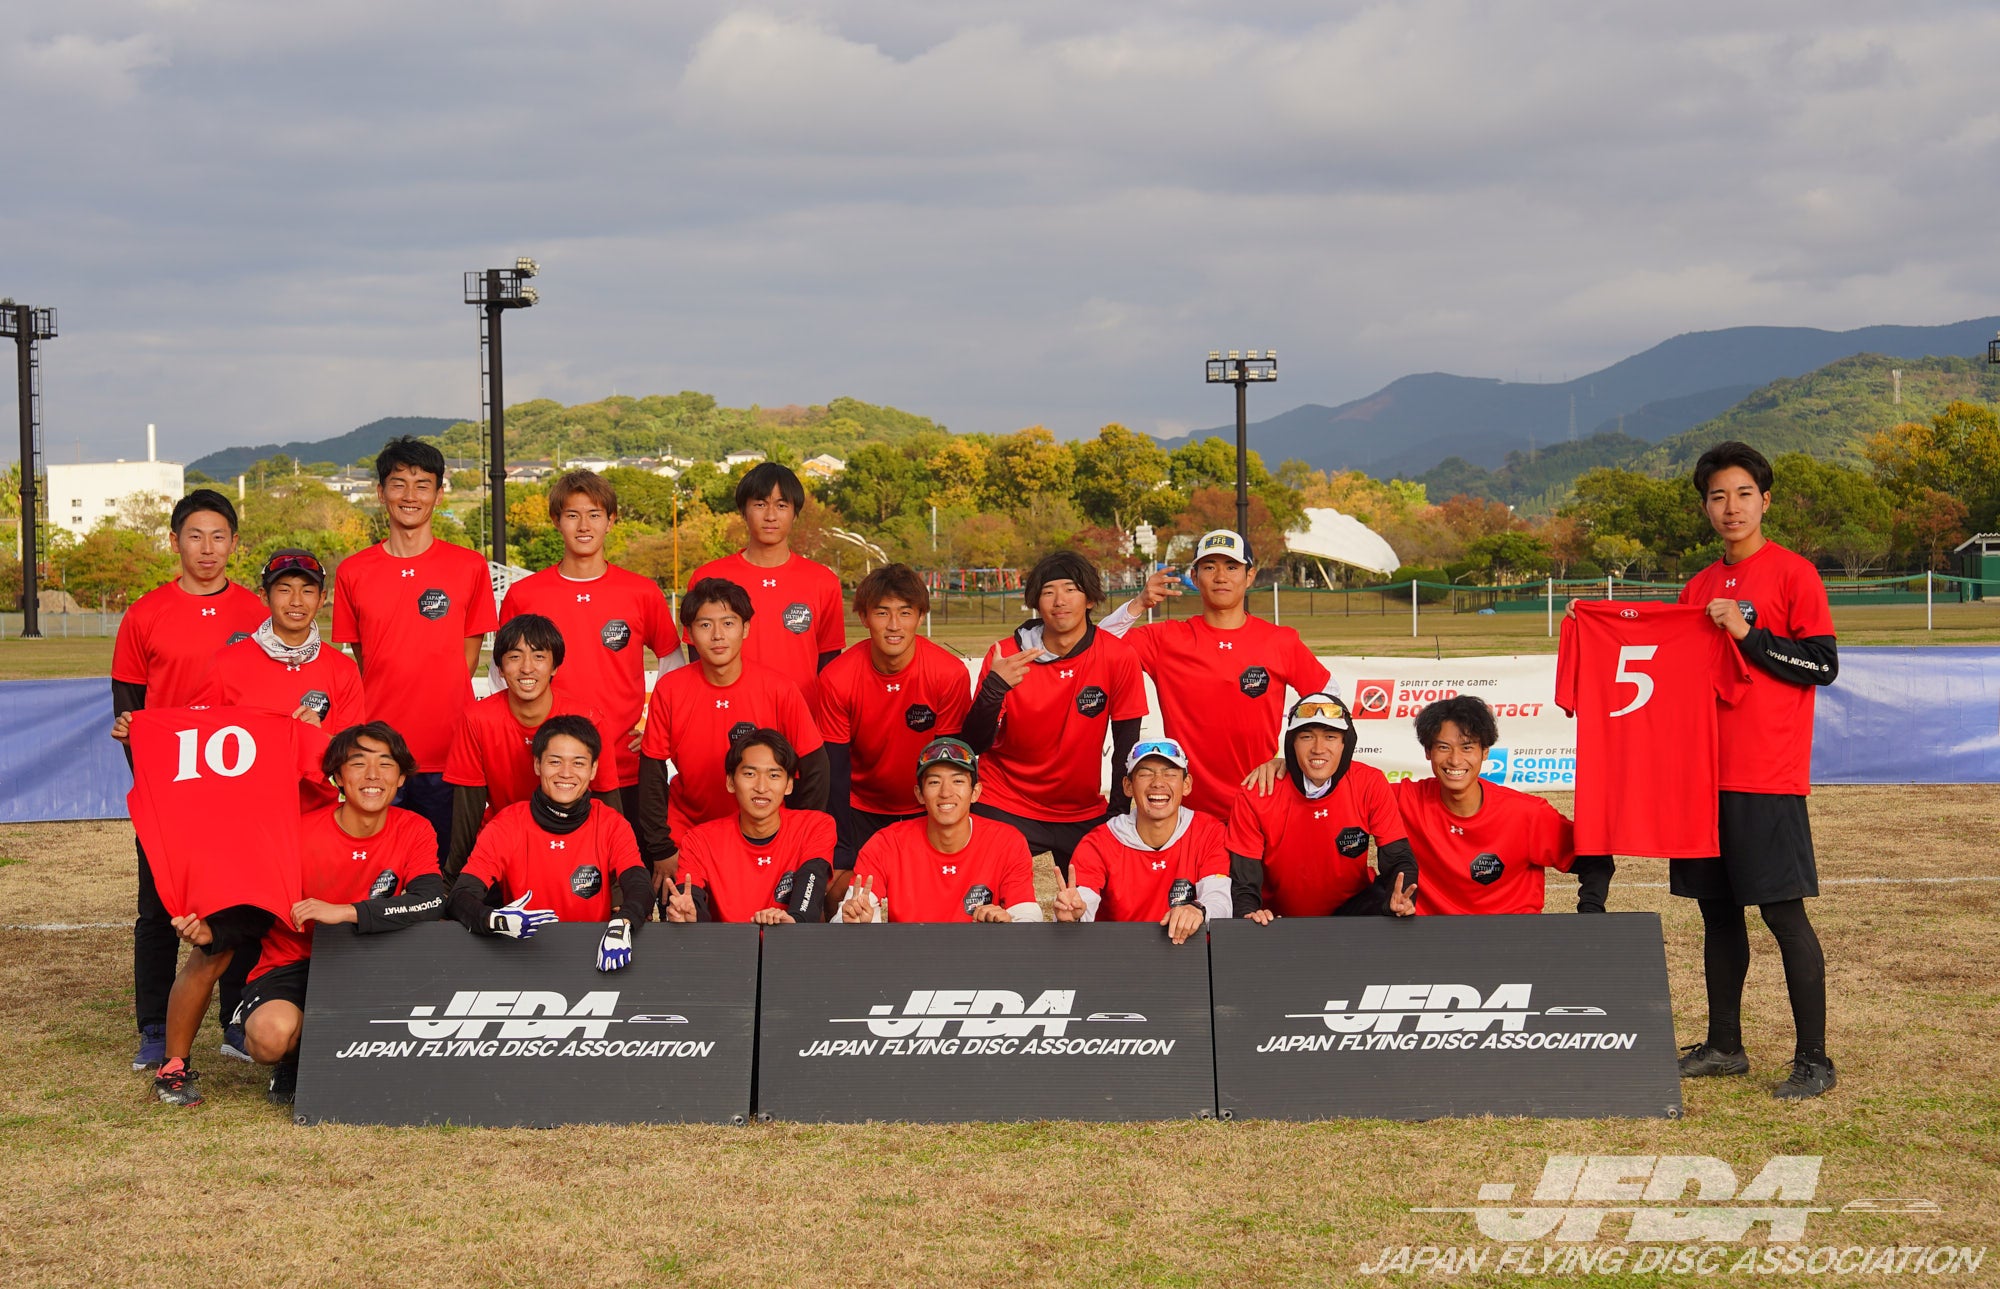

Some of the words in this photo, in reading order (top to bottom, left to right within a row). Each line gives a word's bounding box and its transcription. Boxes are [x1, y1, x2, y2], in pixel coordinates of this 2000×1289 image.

[1609, 645, 1658, 717] 5
[303, 701, 327, 710] ULTIMTE
[173, 725, 257, 782] 10
[383, 905, 408, 916] WHAT
[407, 991, 620, 1039] JFDA
[867, 990, 1076, 1037] JFDA
[1323, 984, 1532, 1032] JFDA
[336, 1041, 416, 1059] JAPAN
[416, 1040, 497, 1058] FLYING
[498, 1040, 558, 1057] DISC
[558, 1040, 715, 1058] ASSOCIATION
[798, 1039, 878, 1057] JAPAN
[879, 1039, 960, 1056] FLYING
[961, 1039, 1020, 1055] DISC
[1020, 1038, 1176, 1056] ASSOCIATION
[1257, 1034, 1336, 1053] JAPAN
[1338, 1034, 1417, 1051] FLYING
[1421, 1033, 1479, 1050] DISC
[1480, 1033, 1637, 1050] ASSOCIATION
